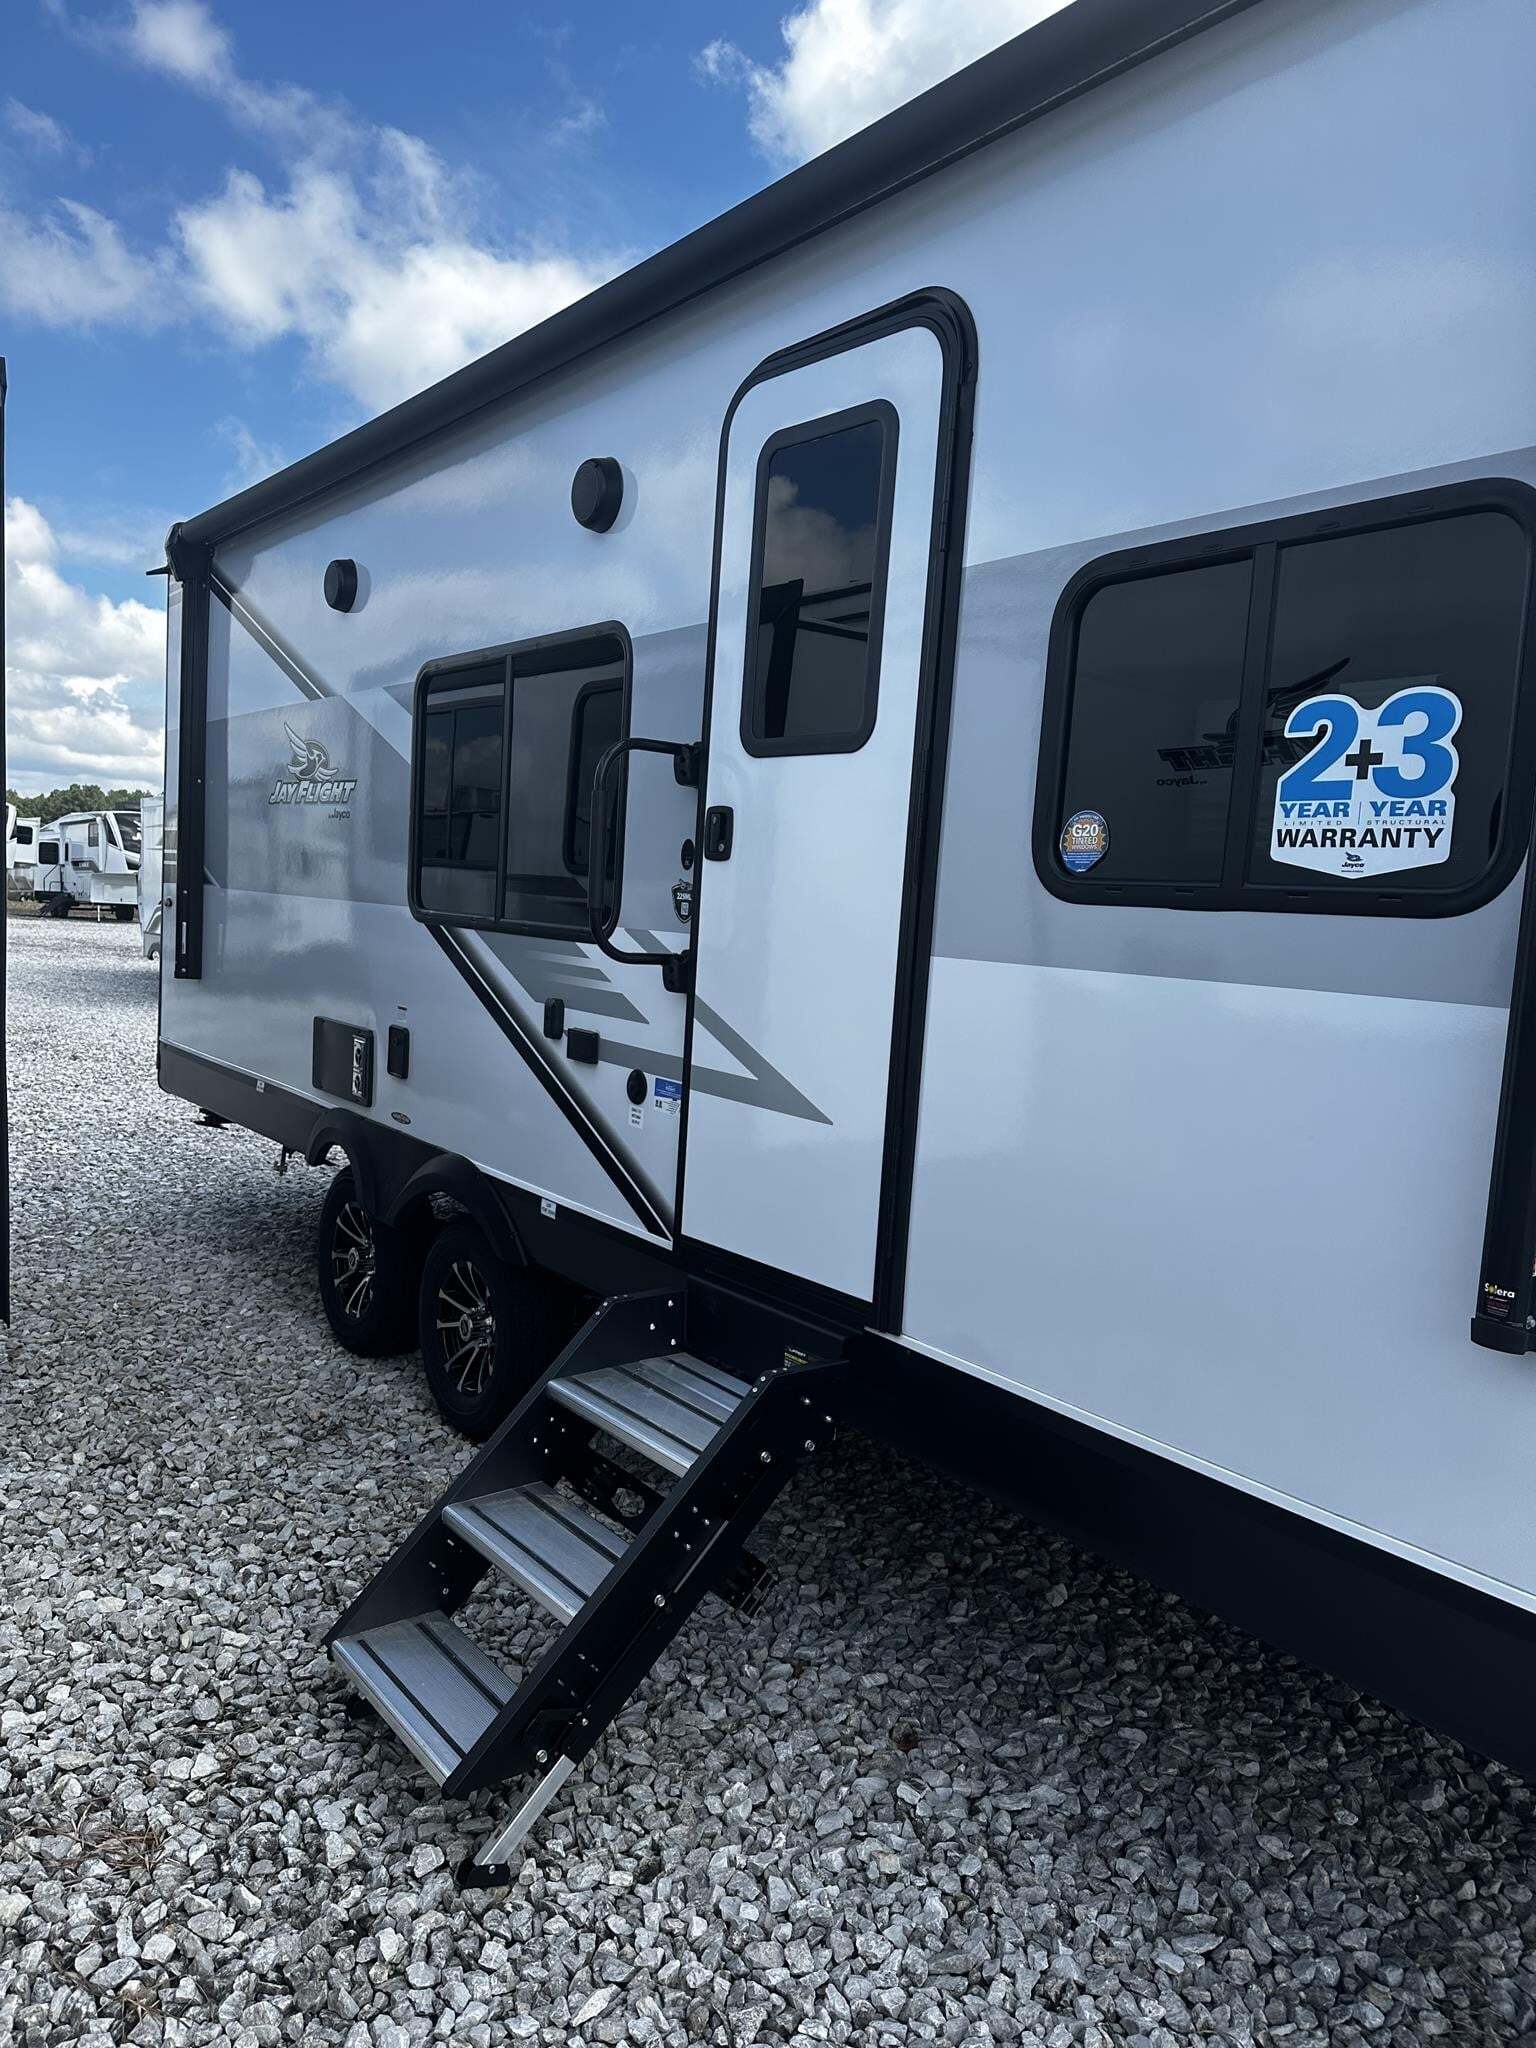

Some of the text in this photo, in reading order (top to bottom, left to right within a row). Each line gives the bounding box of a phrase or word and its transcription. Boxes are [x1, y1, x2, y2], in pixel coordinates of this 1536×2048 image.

[1280, 800, 1447, 818] YEAR YEAR
[1366, 818, 1447, 826] STRUCTURAL
[1072, 824, 1099, 837] G20
[1276, 827, 1445, 849] WARRANTY
[1484, 1282, 1516, 1298] Solera
